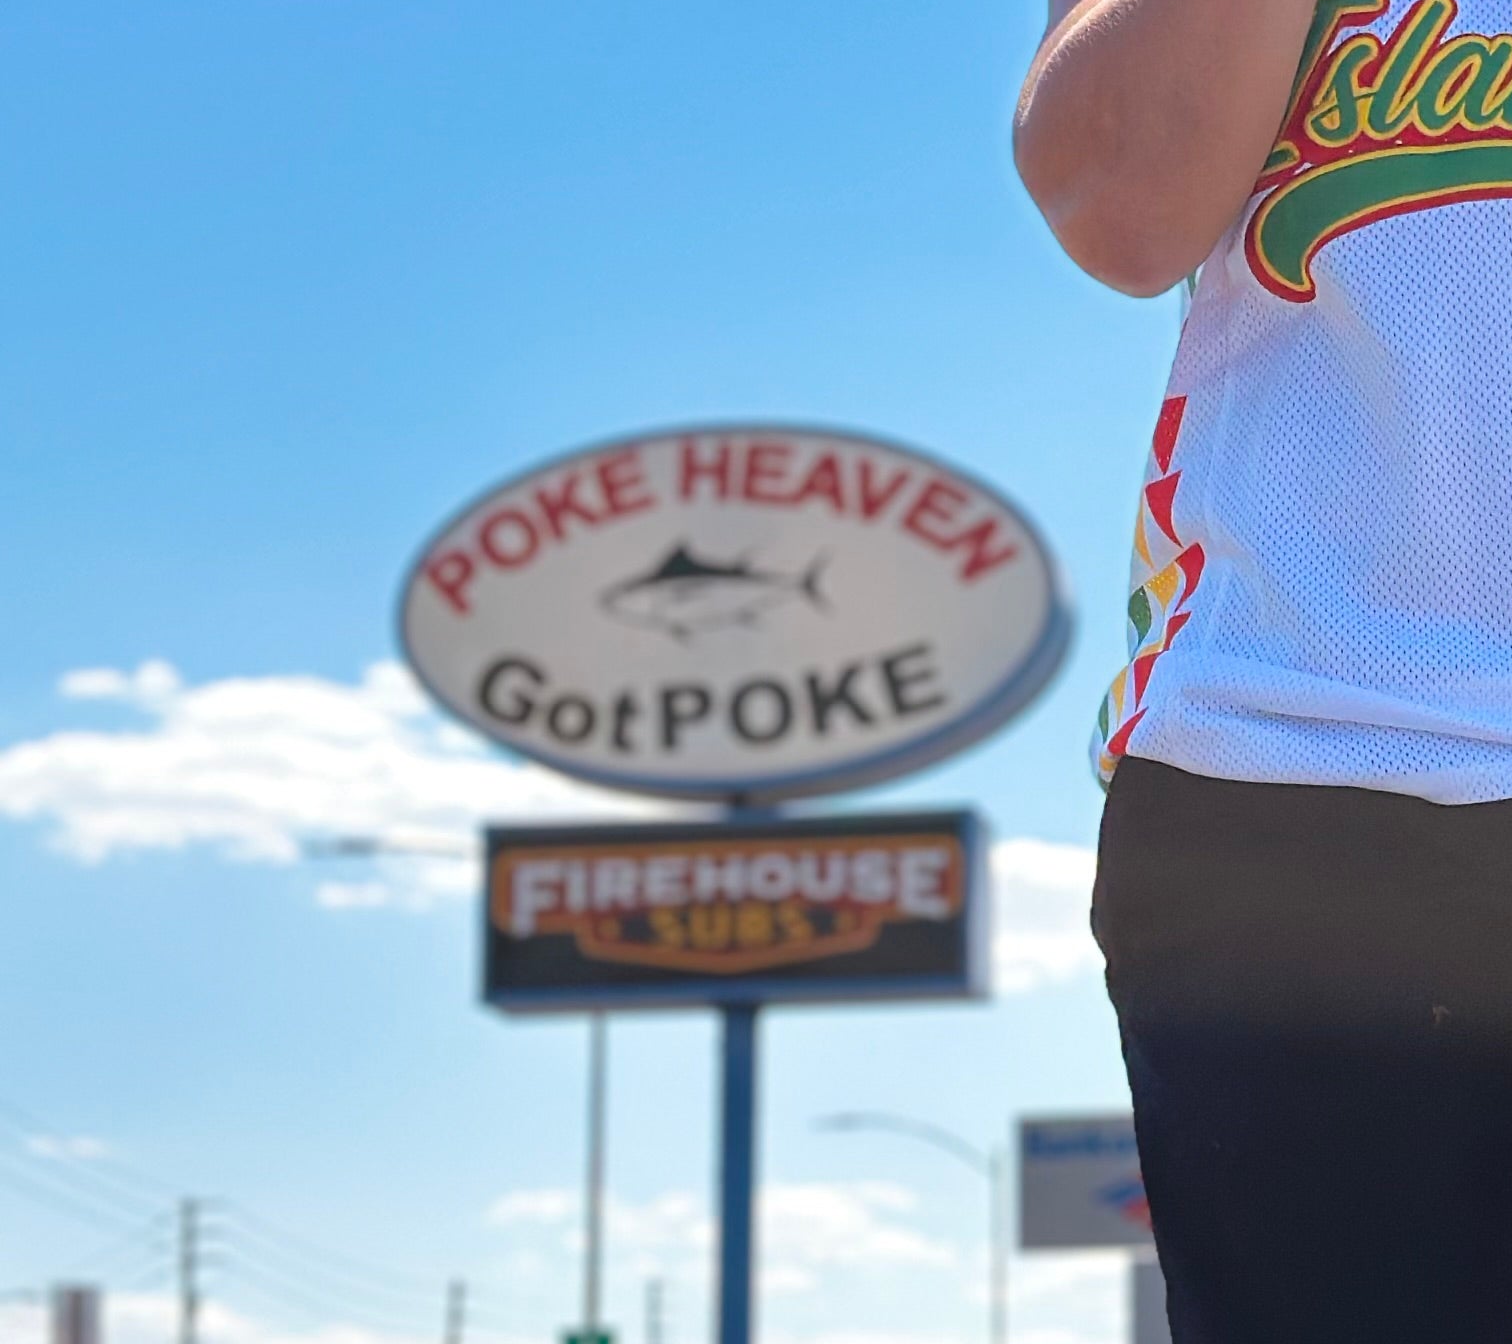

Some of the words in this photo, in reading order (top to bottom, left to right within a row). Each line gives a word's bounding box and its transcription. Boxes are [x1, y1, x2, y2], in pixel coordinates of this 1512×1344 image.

[424, 449, 656, 615] POKE
[677, 438, 1018, 585] HEAVEN
[508, 847, 953, 939] FIREHOUSE
[648, 900, 816, 952] SUBS
